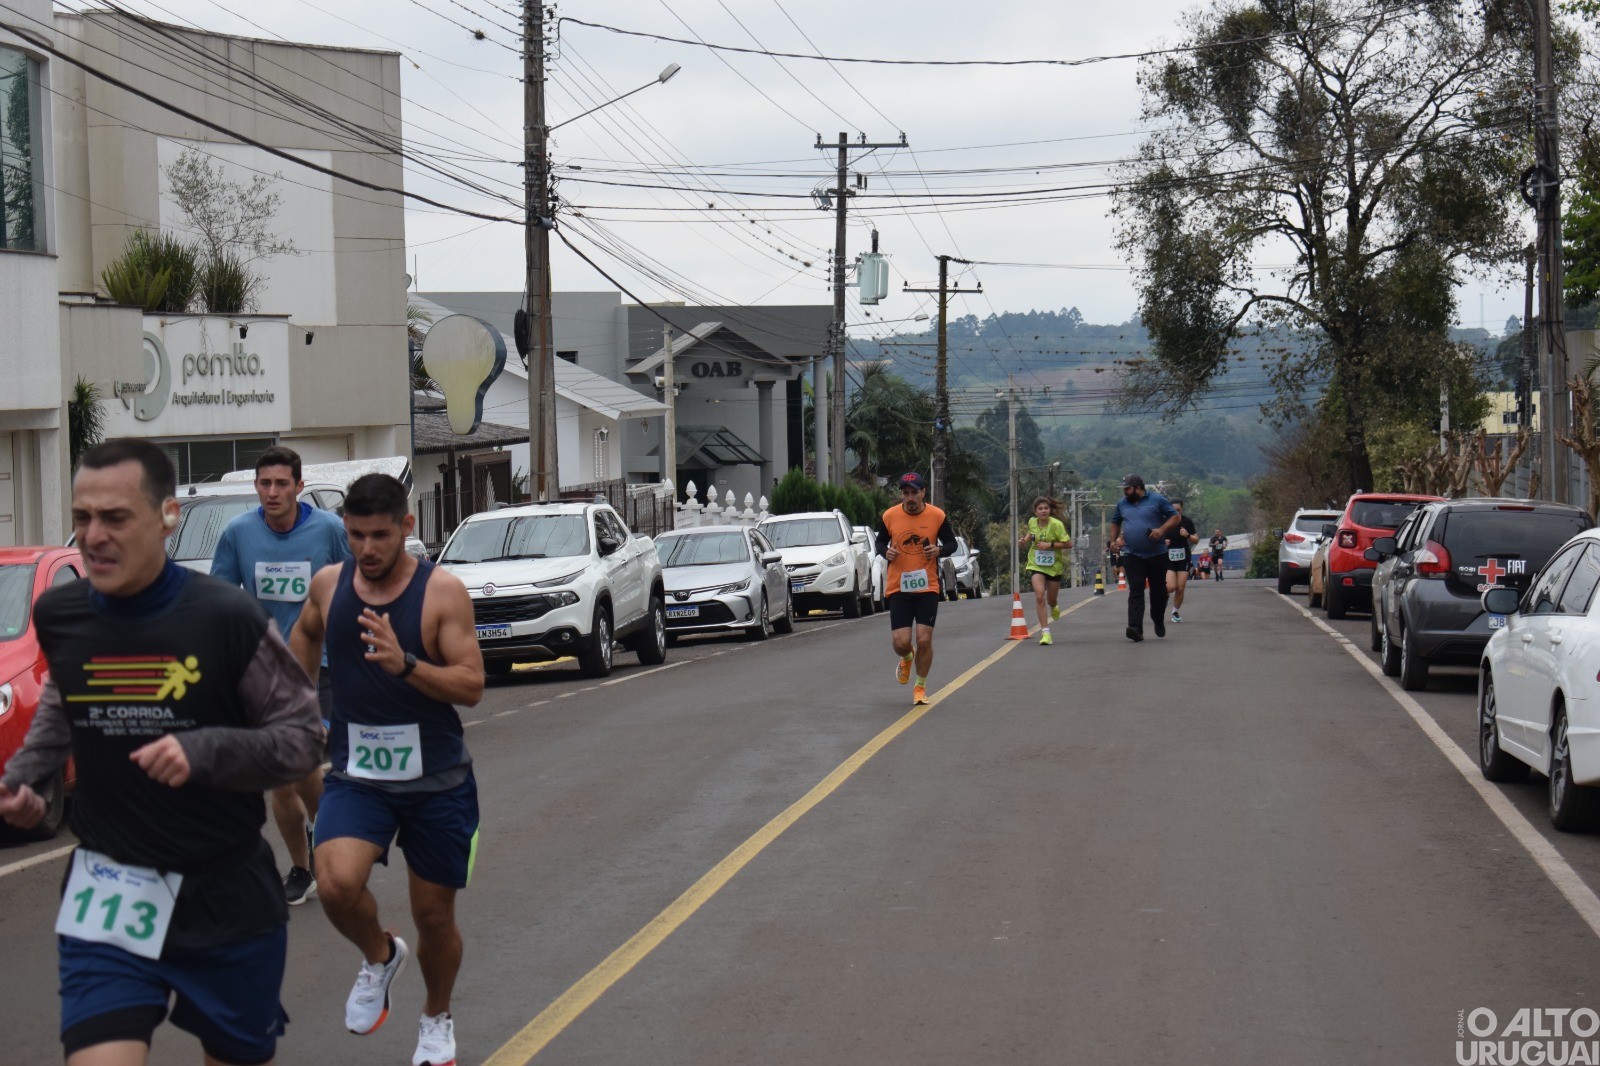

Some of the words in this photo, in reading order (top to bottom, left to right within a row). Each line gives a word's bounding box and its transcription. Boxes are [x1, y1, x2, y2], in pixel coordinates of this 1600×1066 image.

[691, 361, 743, 379] OAB
[172, 391, 221, 408] Arquitetura
[227, 389, 275, 407] Engenharia
[1036, 555, 1053, 563] 122
[1507, 560, 1526, 574] FIAT
[260, 577, 306, 595] 276
[902, 577, 926, 590] 160
[106, 706, 174, 719] CORRIDA
[355, 745, 413, 771] 207
[74, 886, 159, 942] 113
